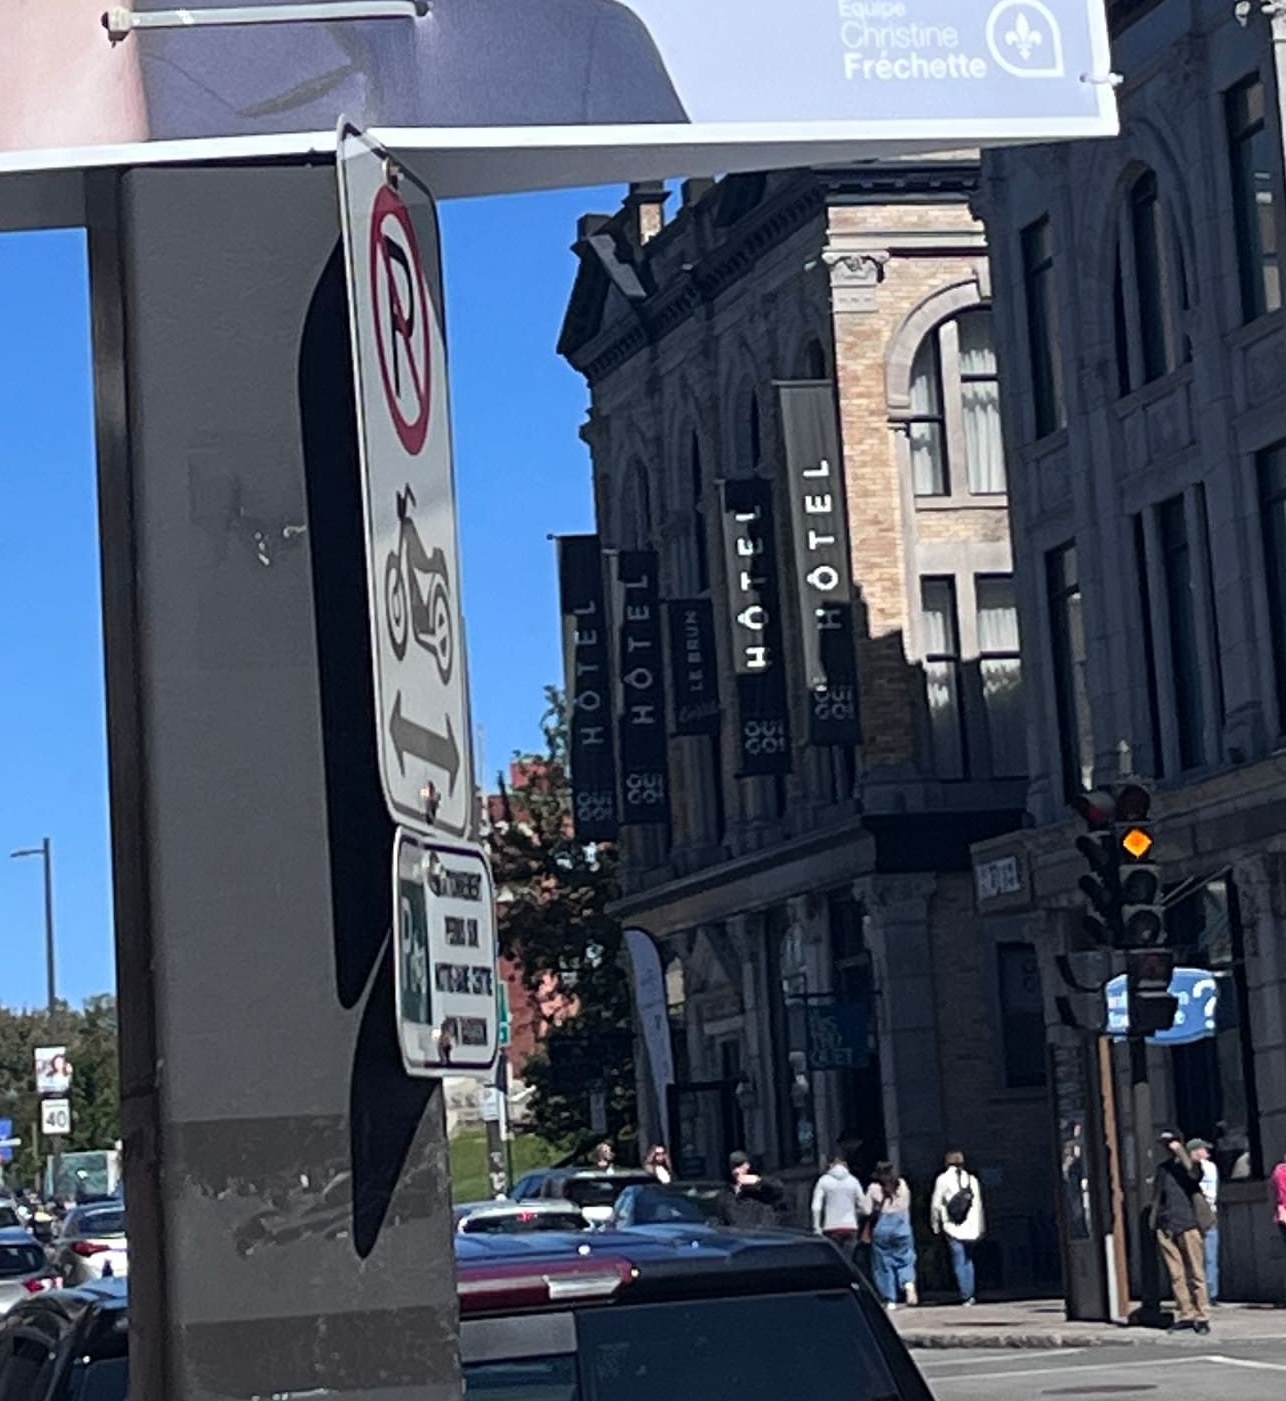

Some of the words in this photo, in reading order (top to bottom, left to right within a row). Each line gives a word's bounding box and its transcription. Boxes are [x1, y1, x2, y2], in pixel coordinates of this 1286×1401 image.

[840, 20, 959, 49] Christine
[843, 50, 988, 80] Fréchette
[735, 505, 771, 669] HÔTEL
[803, 460, 842, 630] HÔTEL
[573, 599, 605, 746] HÔTEL
[624, 574, 655, 726] HÔTEL
[45, 1110, 67, 1129] 40
